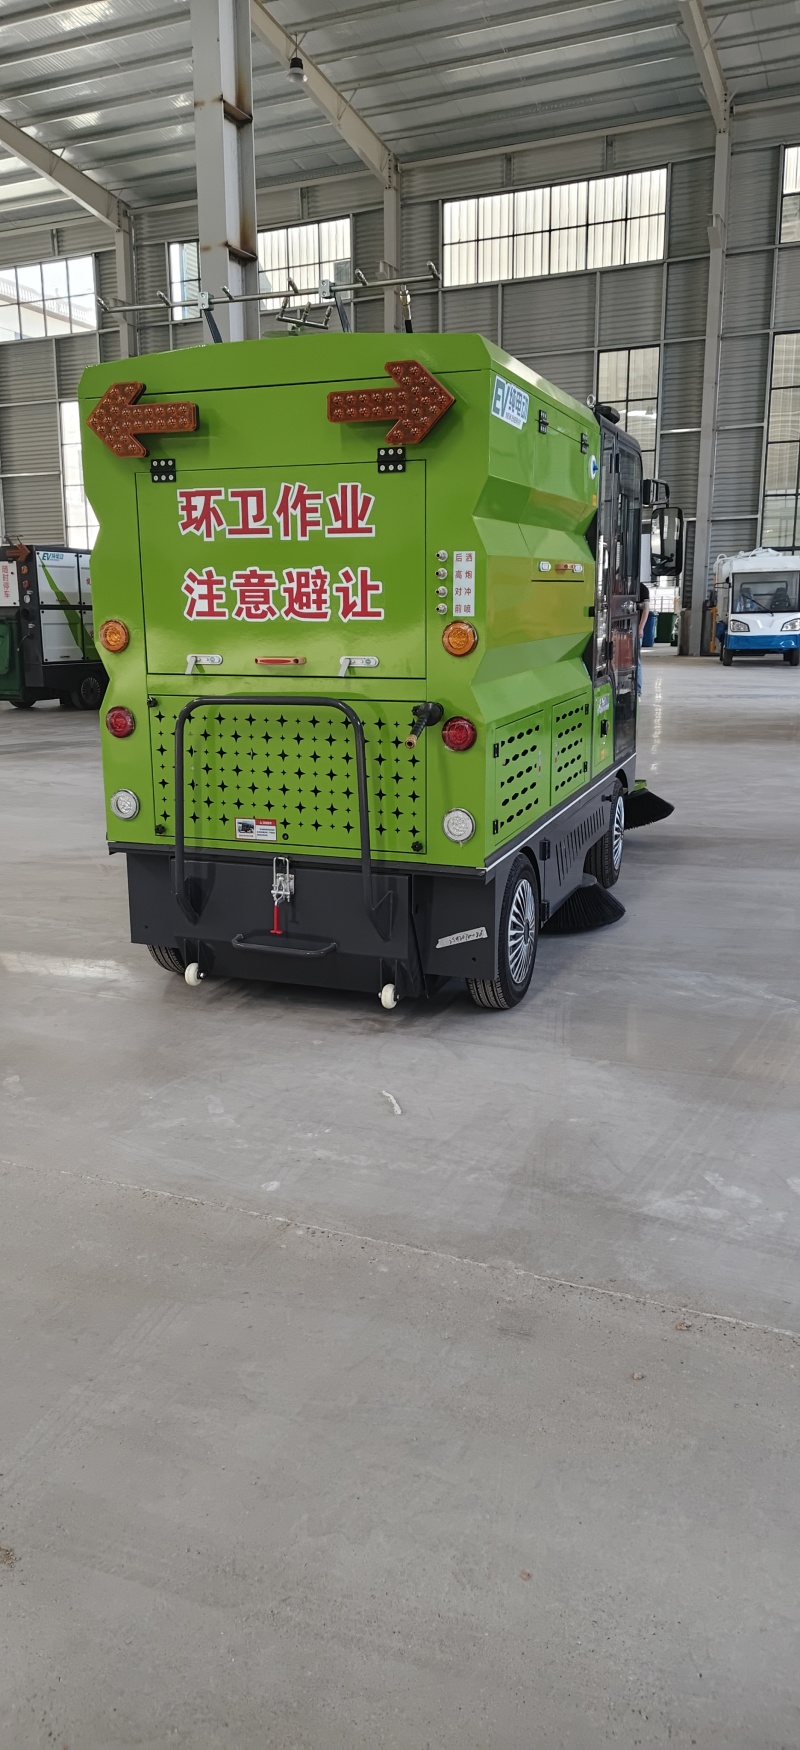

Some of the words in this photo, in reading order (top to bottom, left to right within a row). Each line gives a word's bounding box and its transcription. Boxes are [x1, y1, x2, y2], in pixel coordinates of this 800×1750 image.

[177, 482, 375, 541] 环卫作业
[181, 566, 384, 622] 注意避让
[454, 587, 472, 596] 对冲
